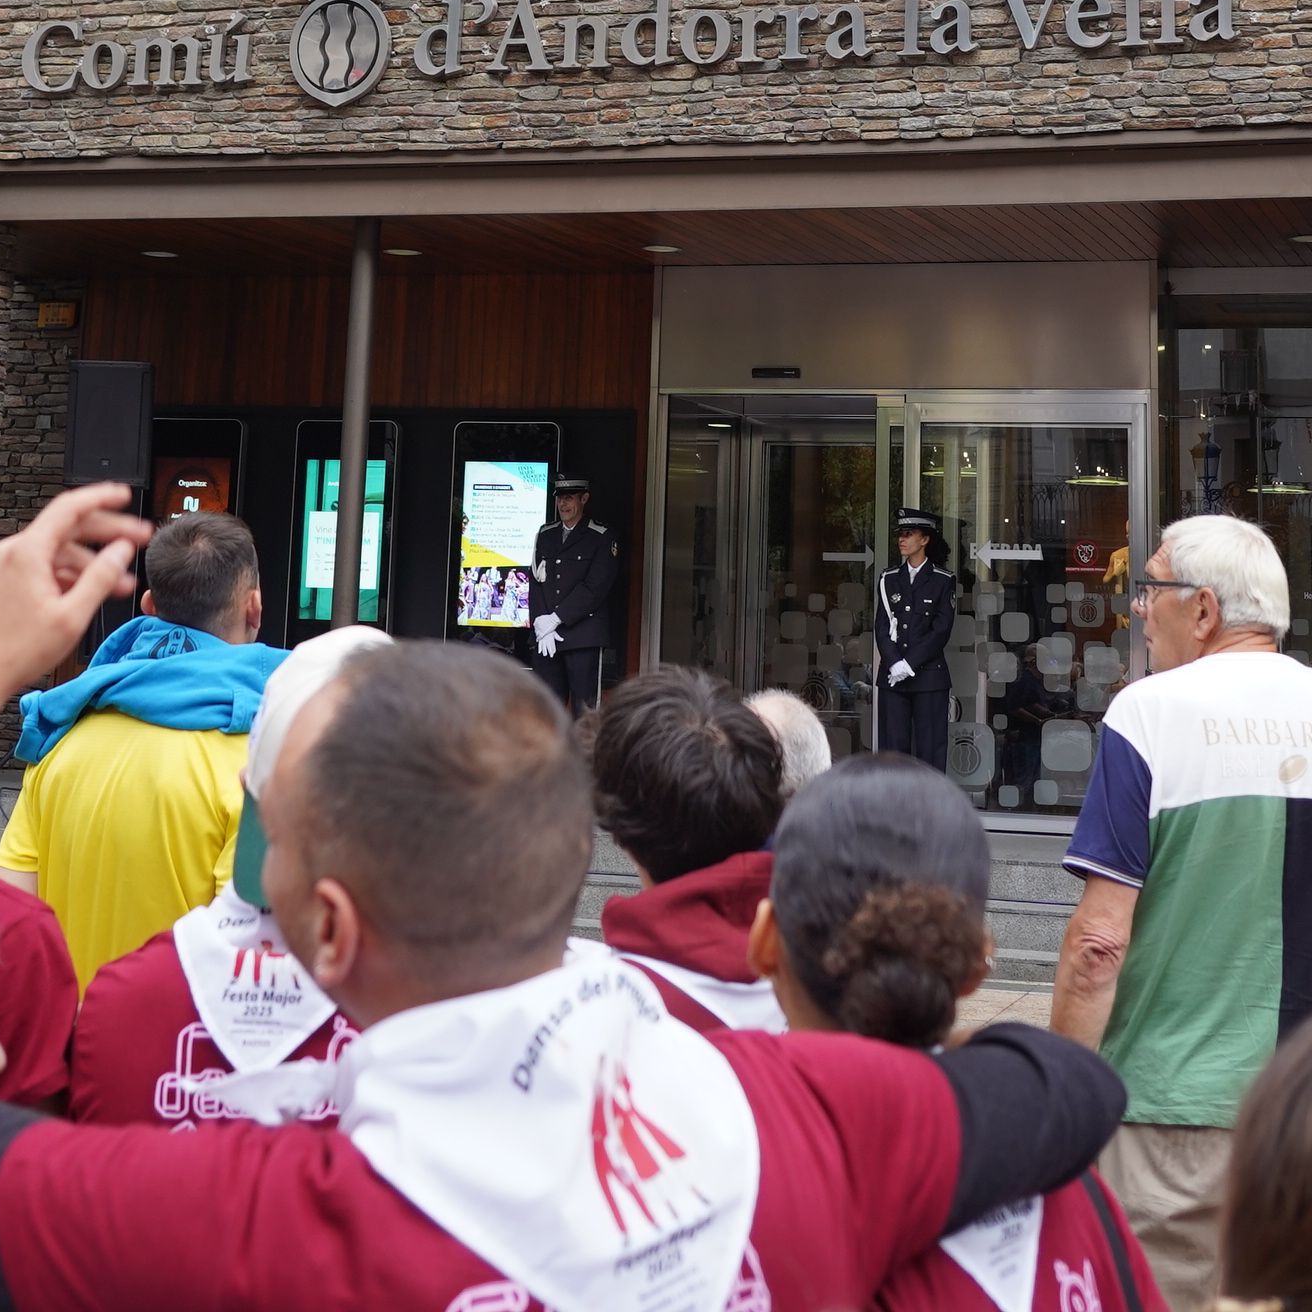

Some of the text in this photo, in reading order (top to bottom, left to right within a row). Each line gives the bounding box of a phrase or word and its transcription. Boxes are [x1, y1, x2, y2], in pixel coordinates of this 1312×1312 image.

[22, 12, 253, 95] Comú
[222, 989, 303, 1007] Festa Major
